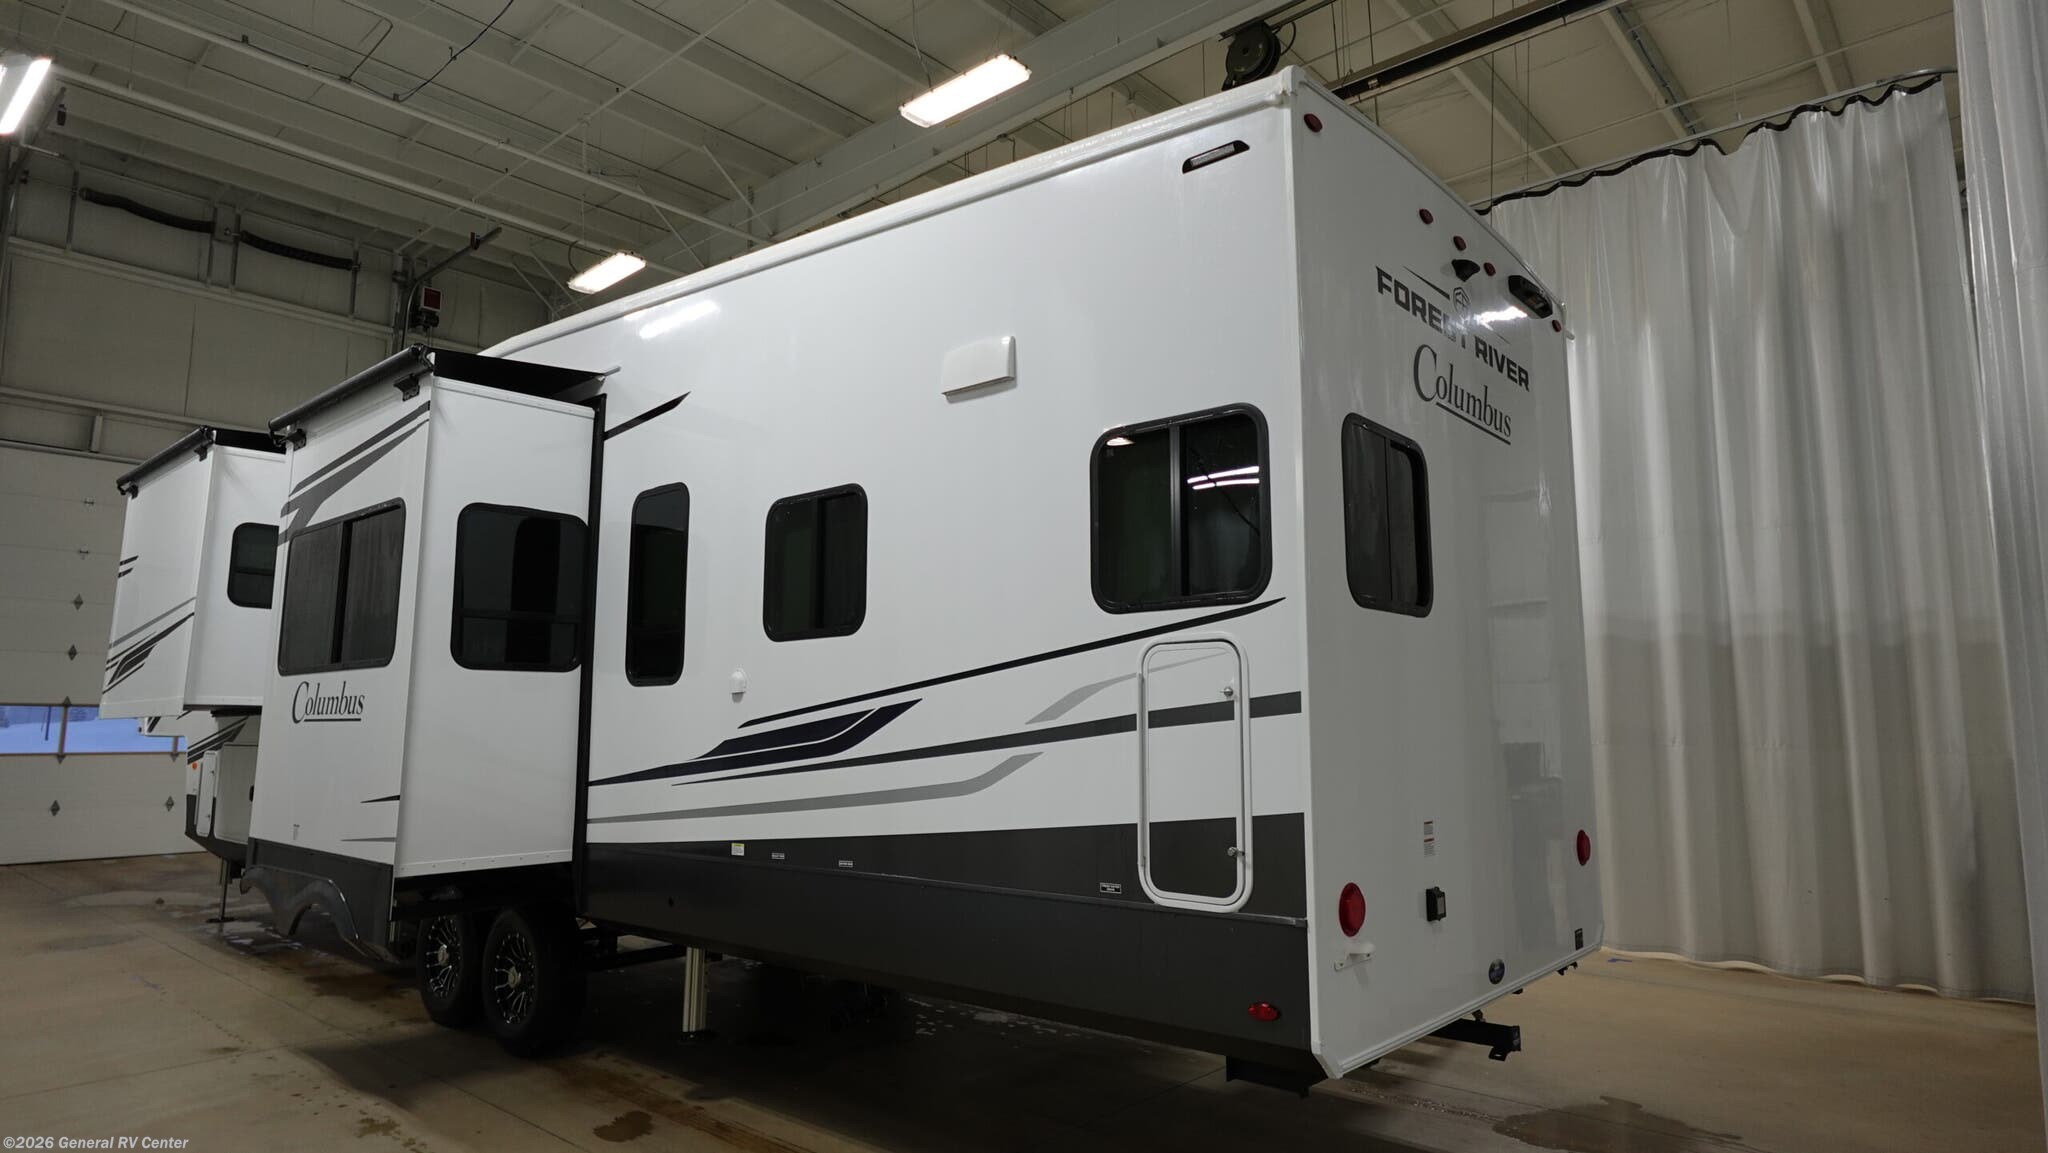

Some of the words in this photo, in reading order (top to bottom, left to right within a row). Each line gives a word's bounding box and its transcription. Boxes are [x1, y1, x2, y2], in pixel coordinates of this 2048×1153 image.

[1413, 344, 1512, 438] Columbus
[1474, 335, 1531, 392] RIVER
[291, 680, 366, 724] Columbus
